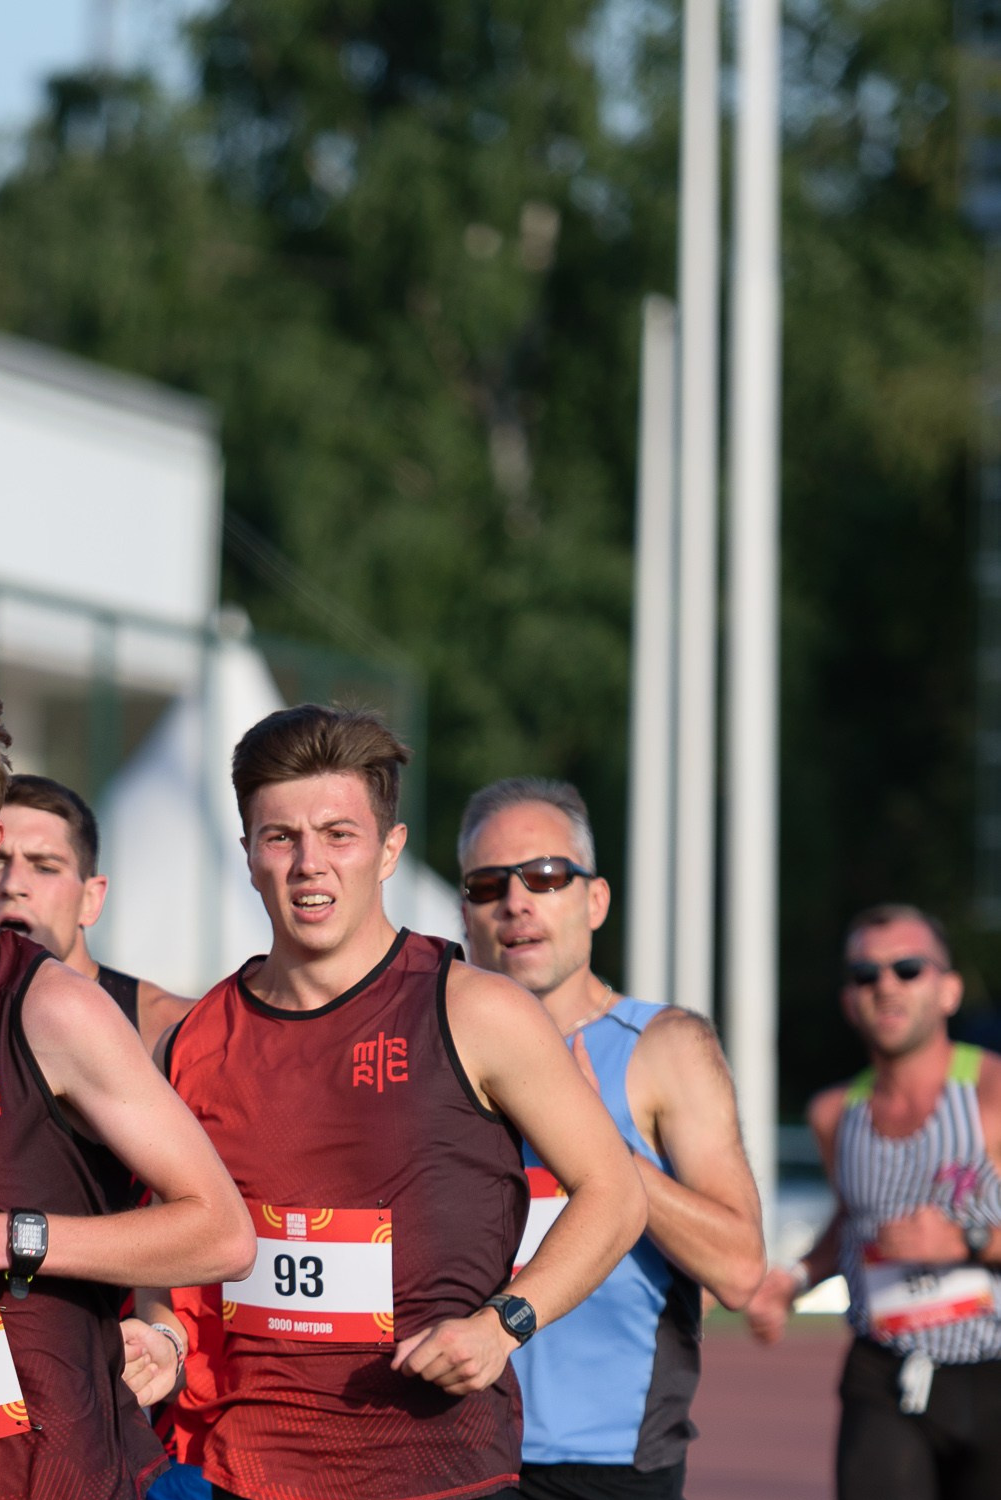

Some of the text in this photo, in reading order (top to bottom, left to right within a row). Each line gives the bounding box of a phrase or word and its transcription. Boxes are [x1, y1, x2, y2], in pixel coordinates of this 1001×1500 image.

[274, 1253, 324, 1298] 93
[268, 1317, 333, 1335] 3000 метров
